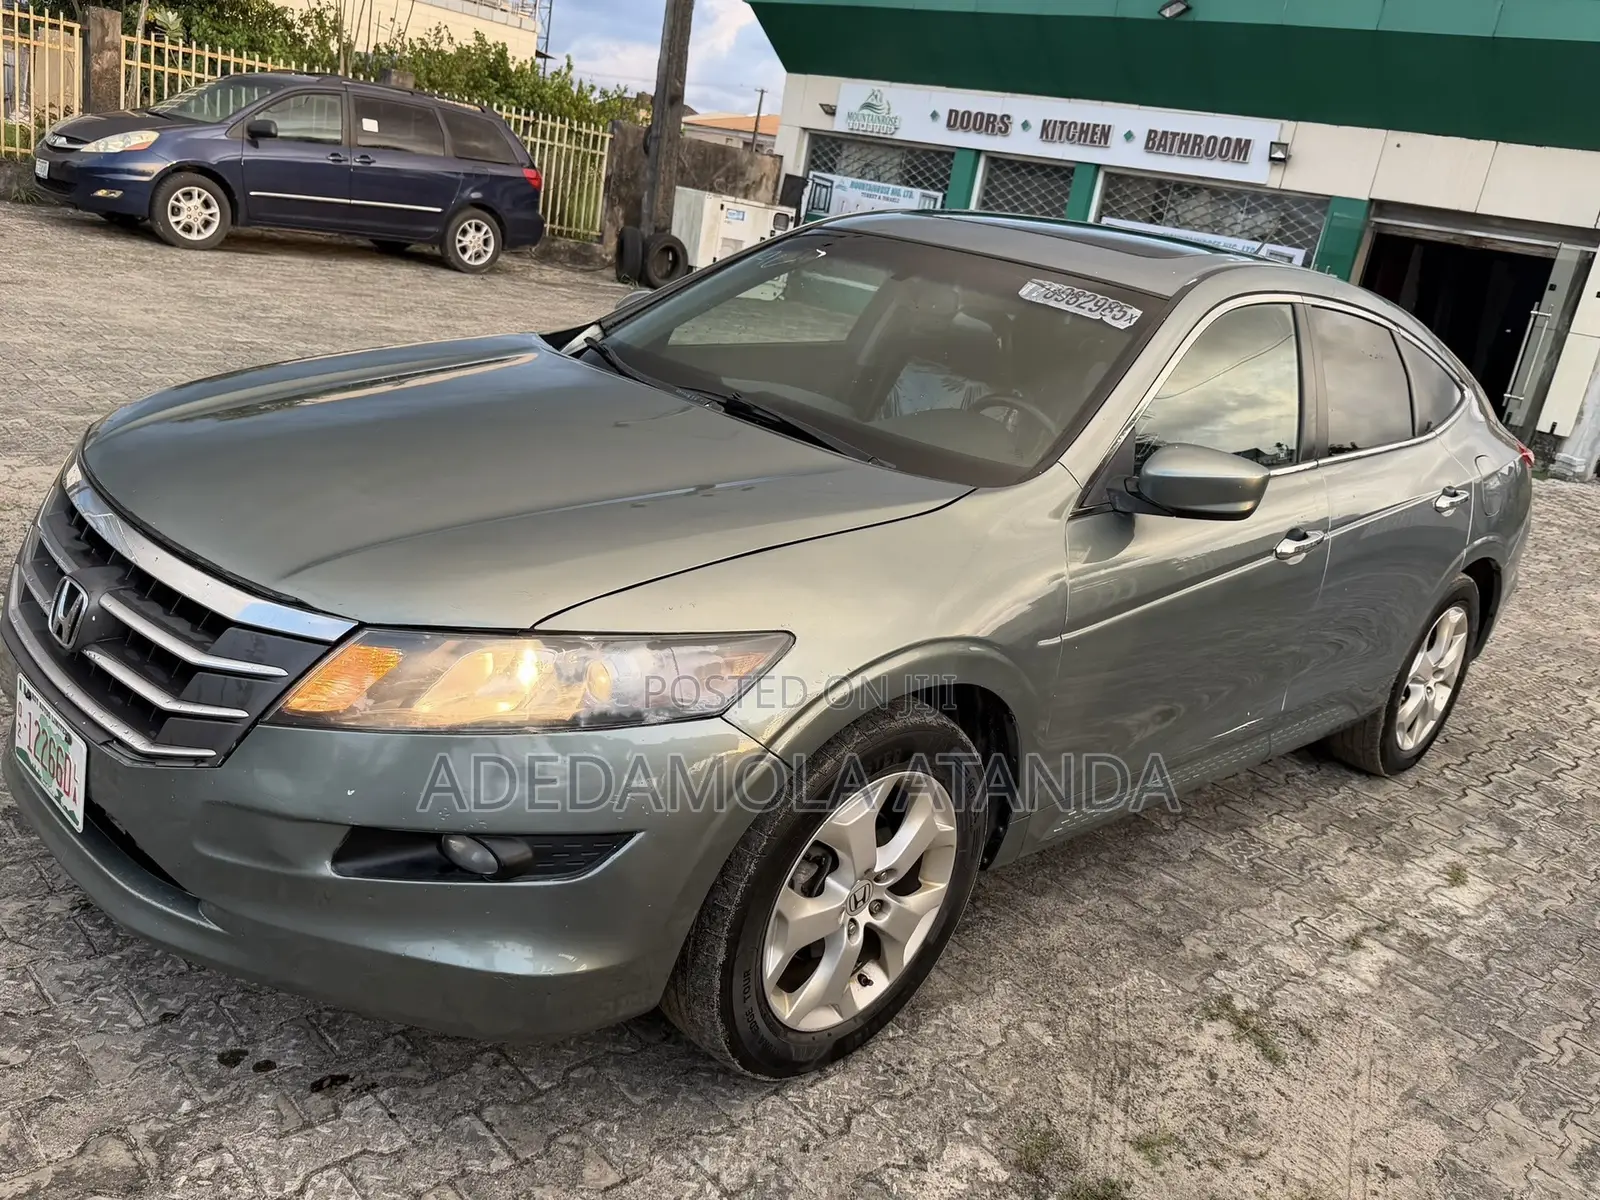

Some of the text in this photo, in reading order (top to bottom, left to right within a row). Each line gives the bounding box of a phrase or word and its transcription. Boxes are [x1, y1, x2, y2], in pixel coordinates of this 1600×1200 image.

[946, 108, 1254, 164] DOORS KITCHEN BATHROOM
[742, 968, 752, 1003] TOUR
